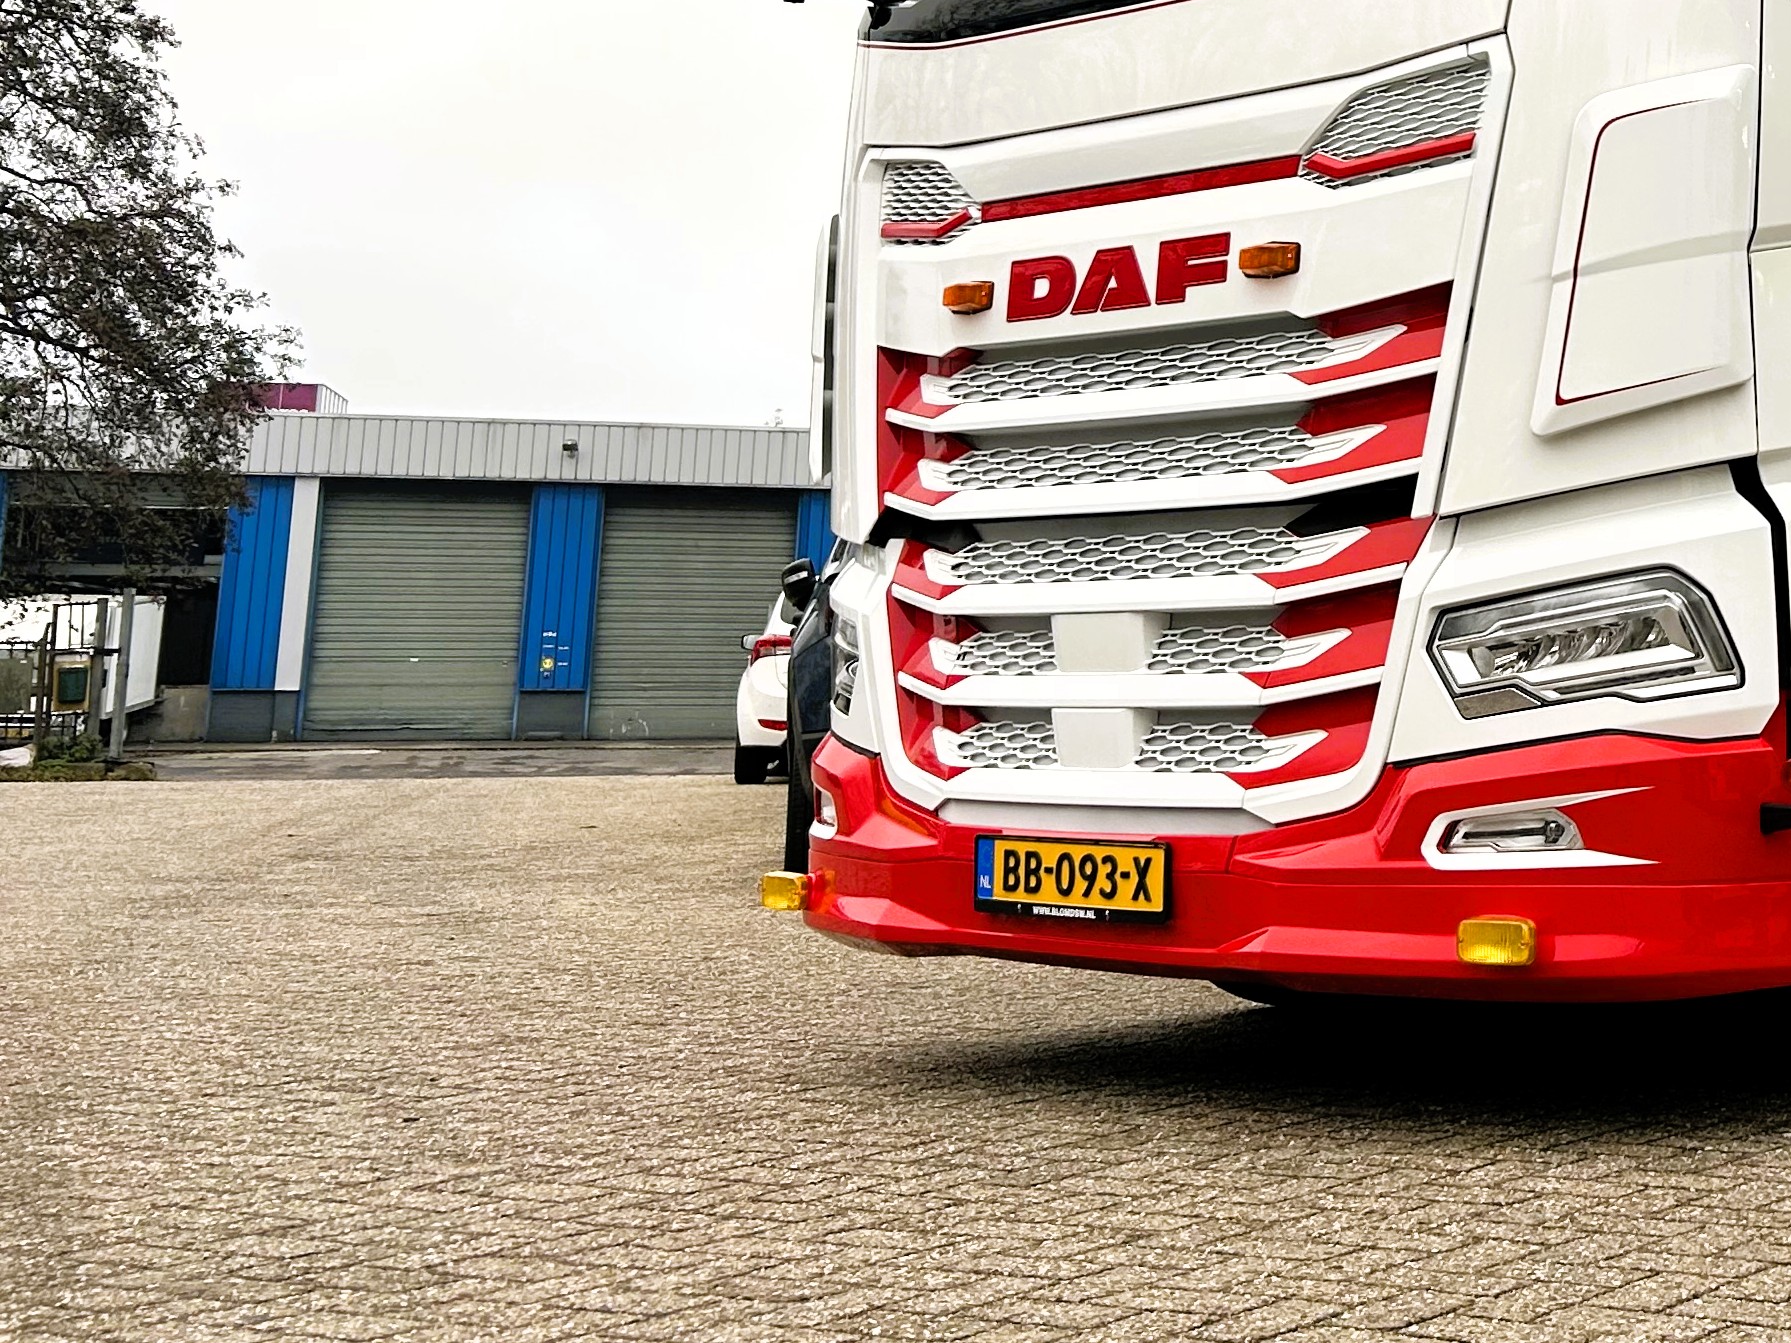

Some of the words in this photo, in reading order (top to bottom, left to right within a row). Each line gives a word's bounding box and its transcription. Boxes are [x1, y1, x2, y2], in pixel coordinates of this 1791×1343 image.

[1006, 231, 1232, 324] DAF
[979, 874, 992, 889] NL
[1002, 848, 1153, 903] BB-093-X
